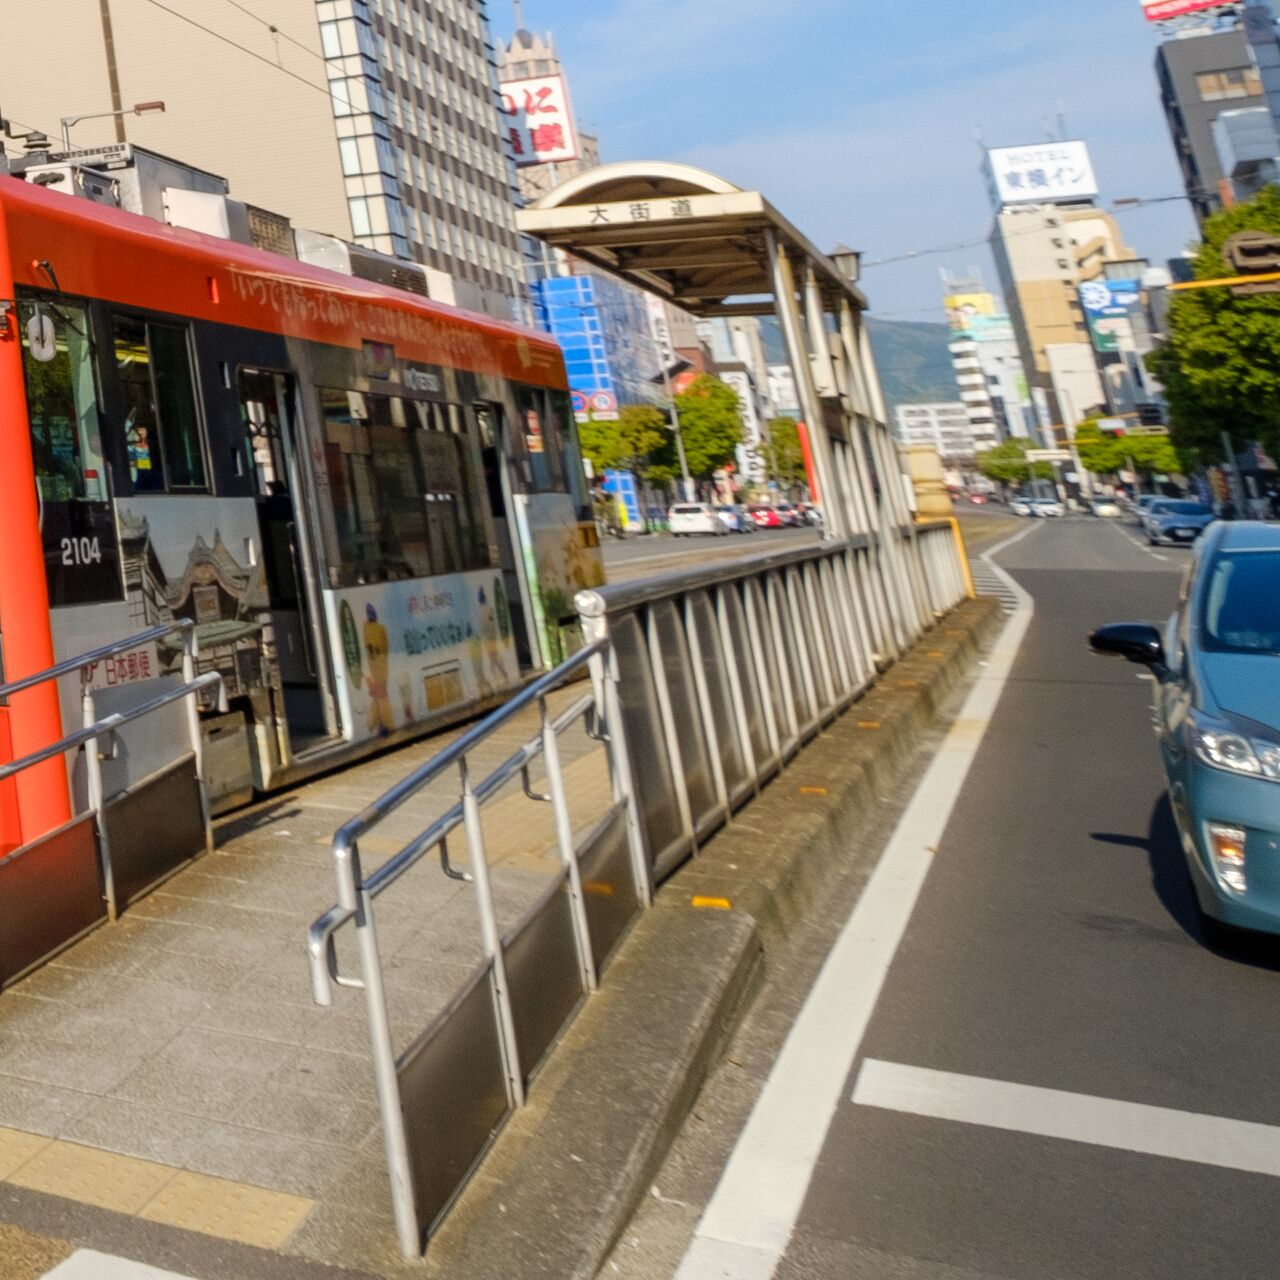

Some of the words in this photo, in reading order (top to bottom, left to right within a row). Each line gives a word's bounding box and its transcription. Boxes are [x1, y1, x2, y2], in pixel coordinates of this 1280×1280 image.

[1006, 151, 1070, 165] HOTEL
[1002, 167, 1087, 190] 東横イン
[588, 199, 694, 224] 大街道
[60, 536, 102, 566] 2104
